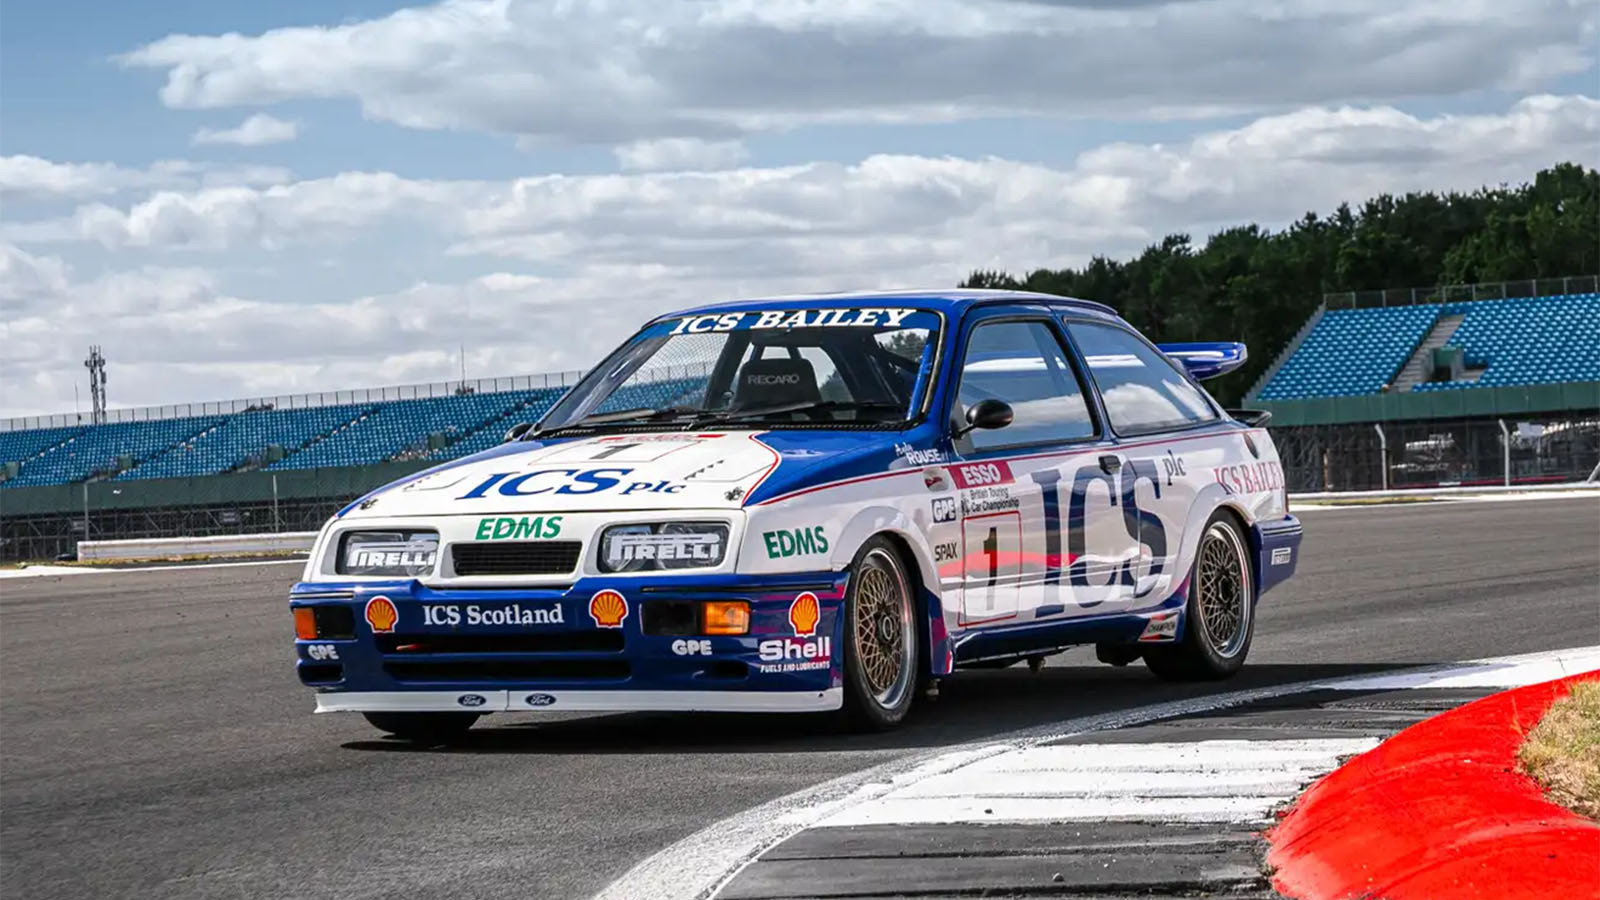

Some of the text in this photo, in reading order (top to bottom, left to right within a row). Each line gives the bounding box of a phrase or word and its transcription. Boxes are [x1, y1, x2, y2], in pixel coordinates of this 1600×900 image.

[669, 309, 917, 335] ICS BAILEY
[747, 374, 800, 385] RECARO
[589, 443, 642, 460] 1
[905, 449, 941, 464] ROUSE
[454, 468, 686, 500] ICS plc
[960, 464, 1001, 486] ESSO
[1213, 465, 1243, 495] ICS
[988, 487, 1009, 499] Touring
[933, 499, 956, 521] GPE
[971, 501, 982, 512] Car
[982, 497, 1020, 511] Championship
[475, 516, 563, 540] EDMS
[1031, 449, 1187, 618] ICS plc
[608, 534, 721, 561] PIRELLI
[763, 526, 829, 559] EDMS
[935, 542, 957, 561] SPAX
[346, 541, 439, 567] PIRELLI
[983, 527, 998, 610] 1
[422, 603, 564, 625] ICS Scotland
[308, 644, 339, 660] GPE
[671, 639, 712, 656] GPE
[759, 636, 831, 661] Shell
[760, 664, 782, 673] FUELS
[783, 662, 795, 671] AND
[530, 695, 550, 705] Ford
